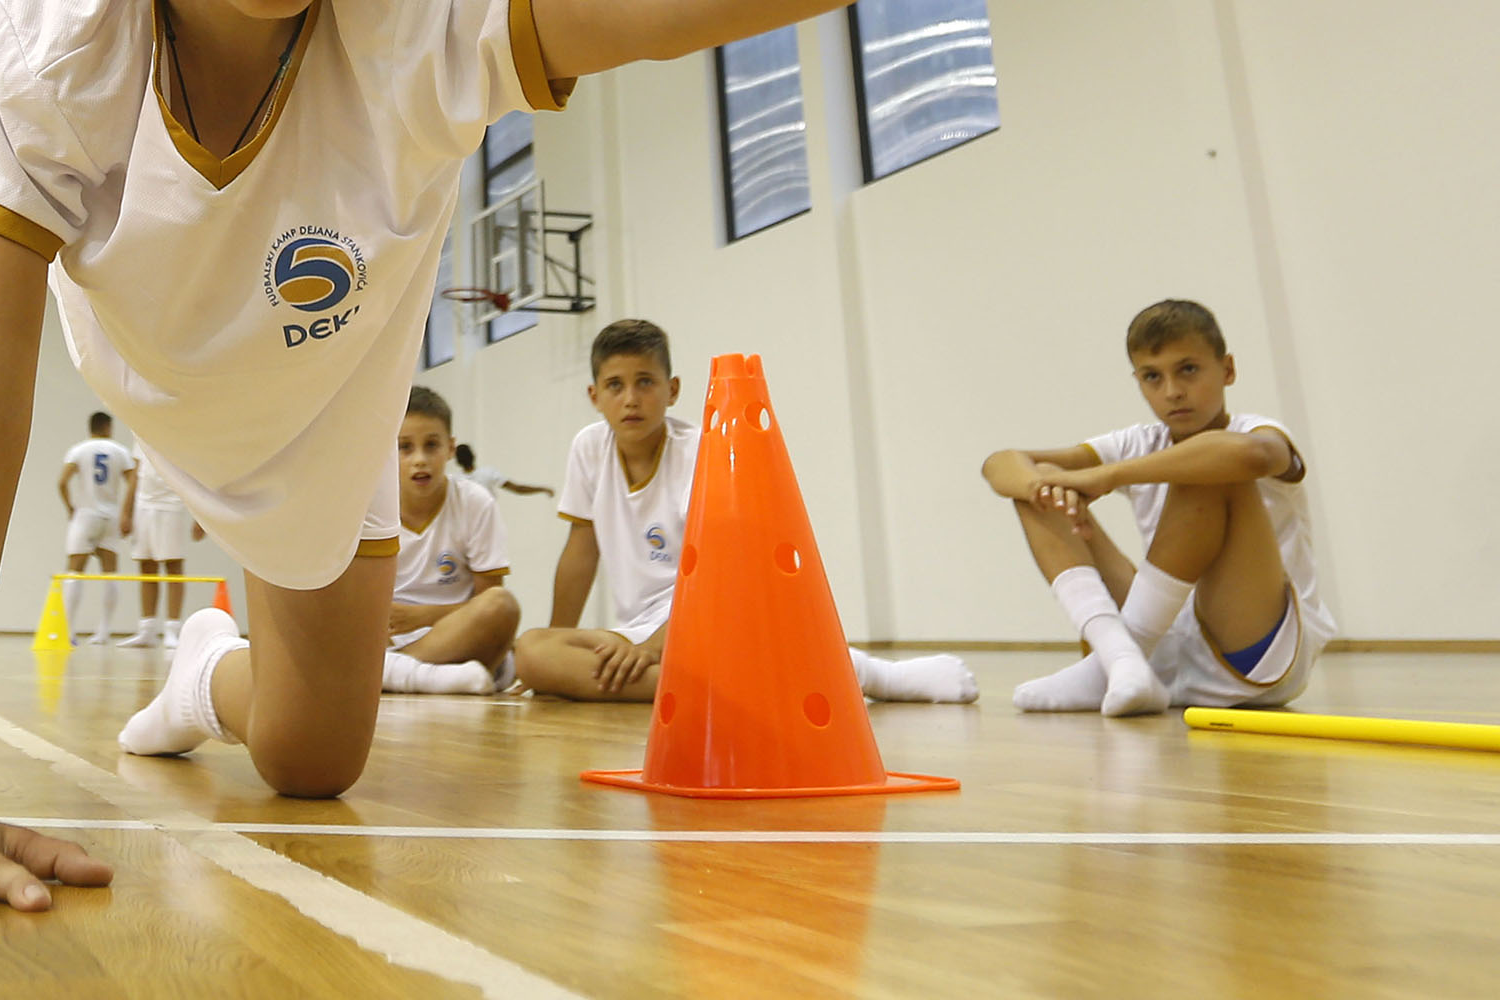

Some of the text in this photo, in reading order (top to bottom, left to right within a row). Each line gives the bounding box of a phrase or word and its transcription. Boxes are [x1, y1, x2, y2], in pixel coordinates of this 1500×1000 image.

[264, 251, 280, 307] FUDBALSKI
[272, 228, 296, 251] KAMP
[299, 225, 339, 240] DEJANA
[94, 453, 108, 486] 5
